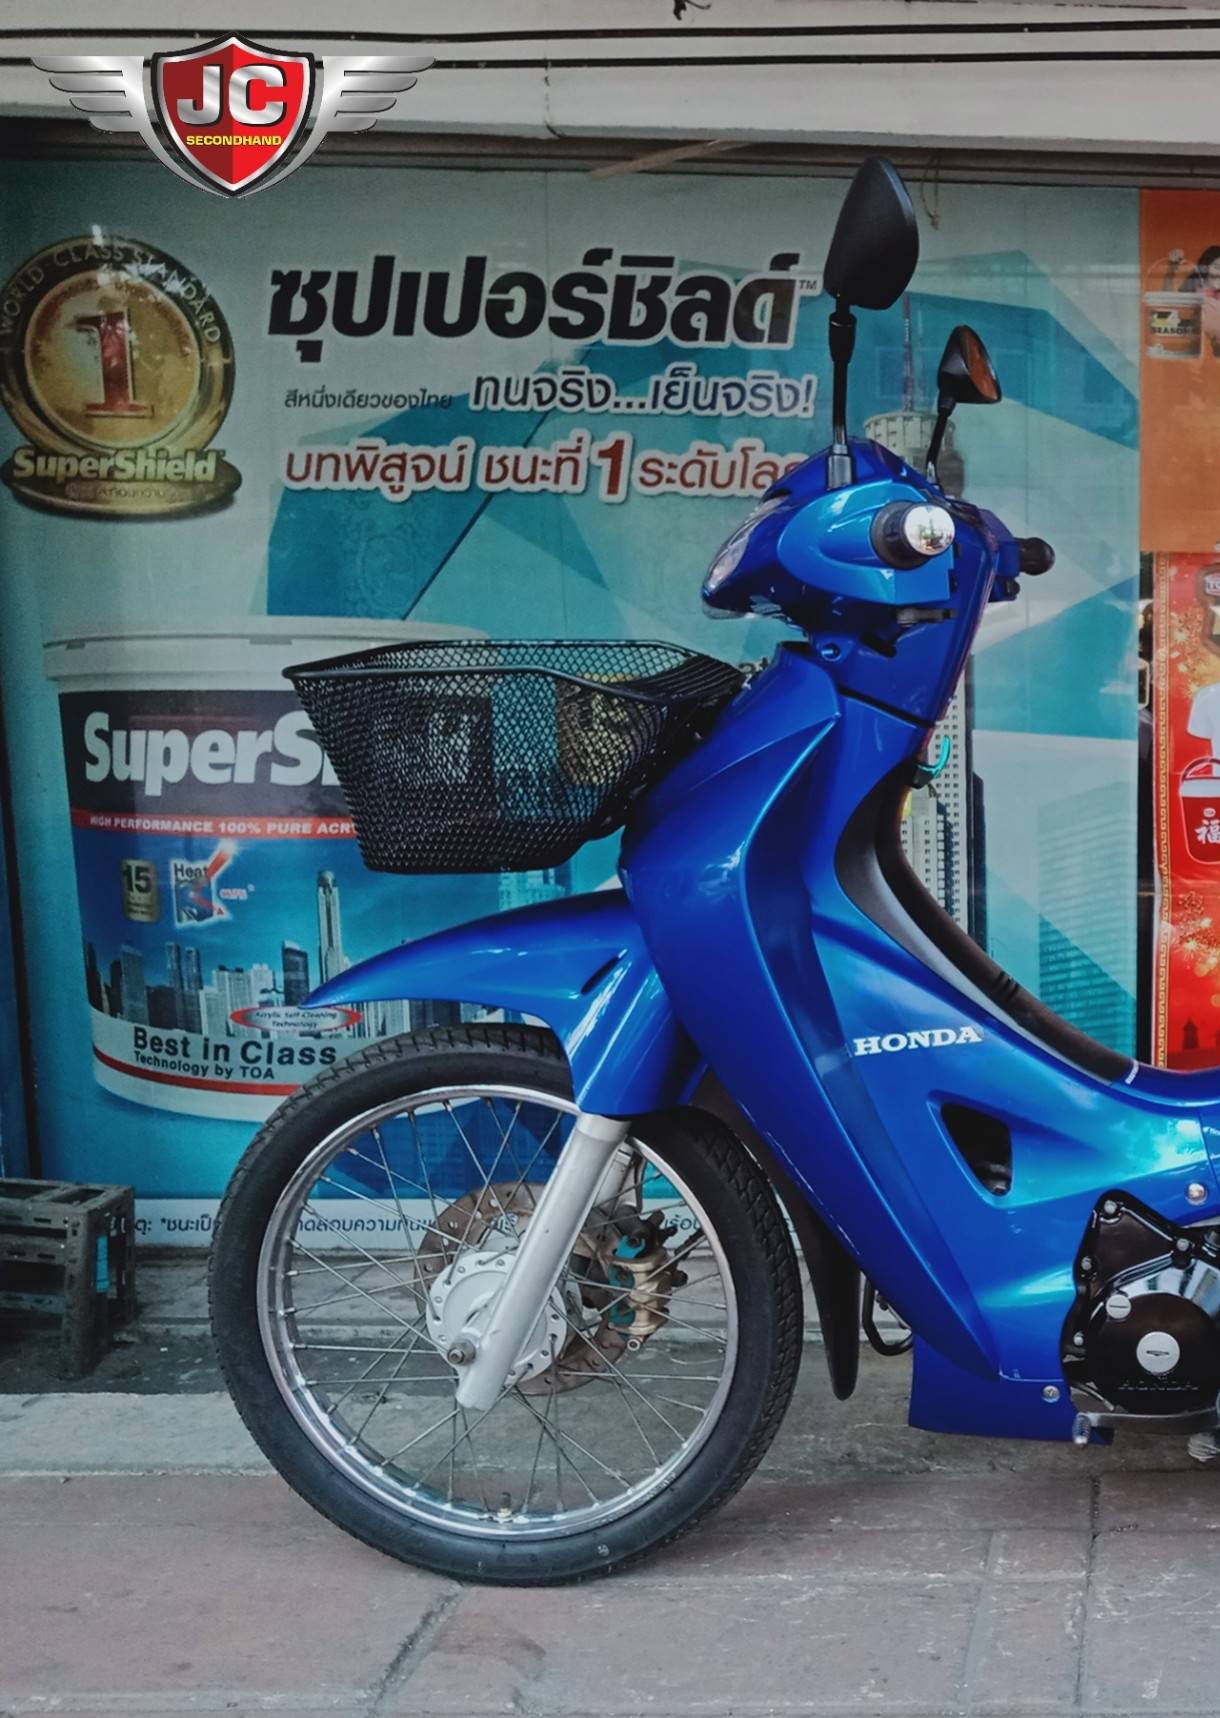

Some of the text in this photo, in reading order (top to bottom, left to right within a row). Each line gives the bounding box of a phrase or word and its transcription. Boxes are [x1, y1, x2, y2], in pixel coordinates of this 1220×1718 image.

[13, 450, 217, 483] SuperShield
[599, 437, 626, 495] 1
[114, 818, 213, 833] PERFORMANCE
[219, 821, 262, 834] 100%
[267, 822, 312, 834] PURE
[124, 864, 152, 894] 15
[133, 1026, 337, 1066] Best in Class
[853, 1025, 984, 1057] HONDA
[134, 1050, 275, 1080] Technology by TOA
